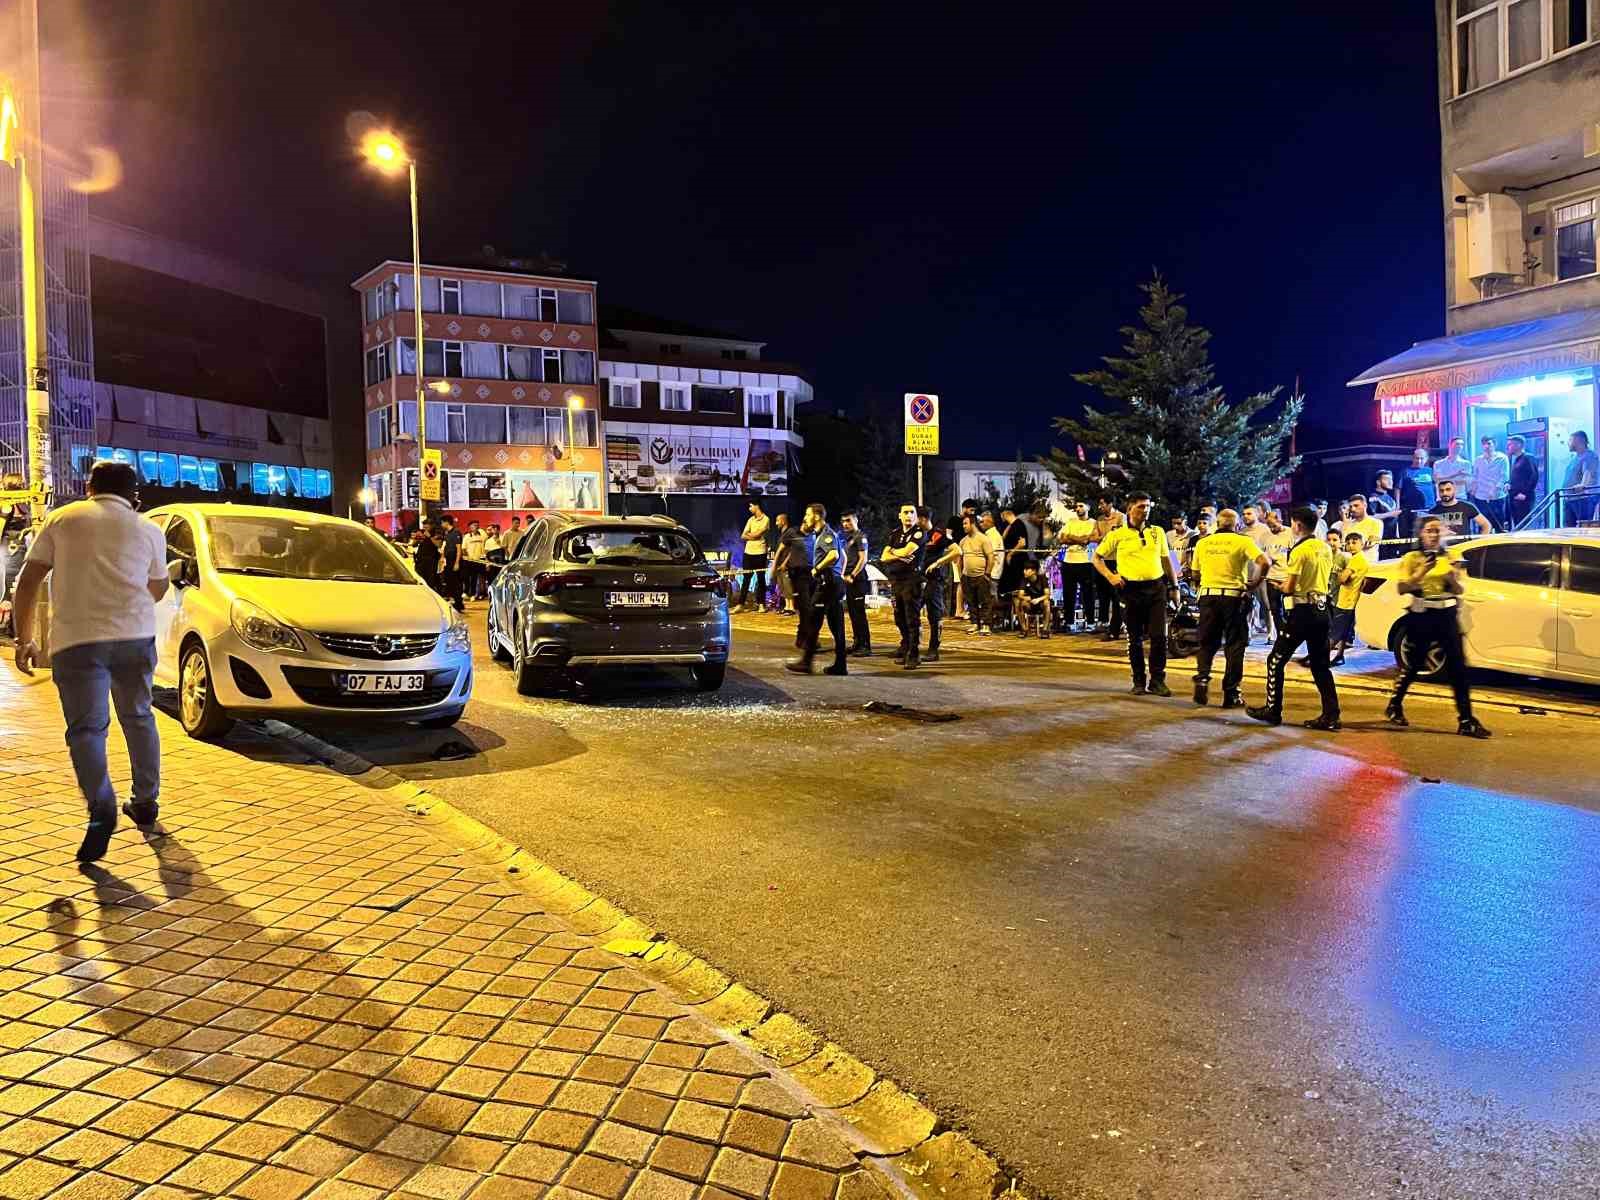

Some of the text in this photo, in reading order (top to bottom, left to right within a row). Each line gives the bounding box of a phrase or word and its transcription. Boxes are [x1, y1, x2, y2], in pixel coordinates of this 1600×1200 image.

[611, 593, 667, 603] 34 HUR 442
[349, 676, 422, 690] 07 FAJ 33
